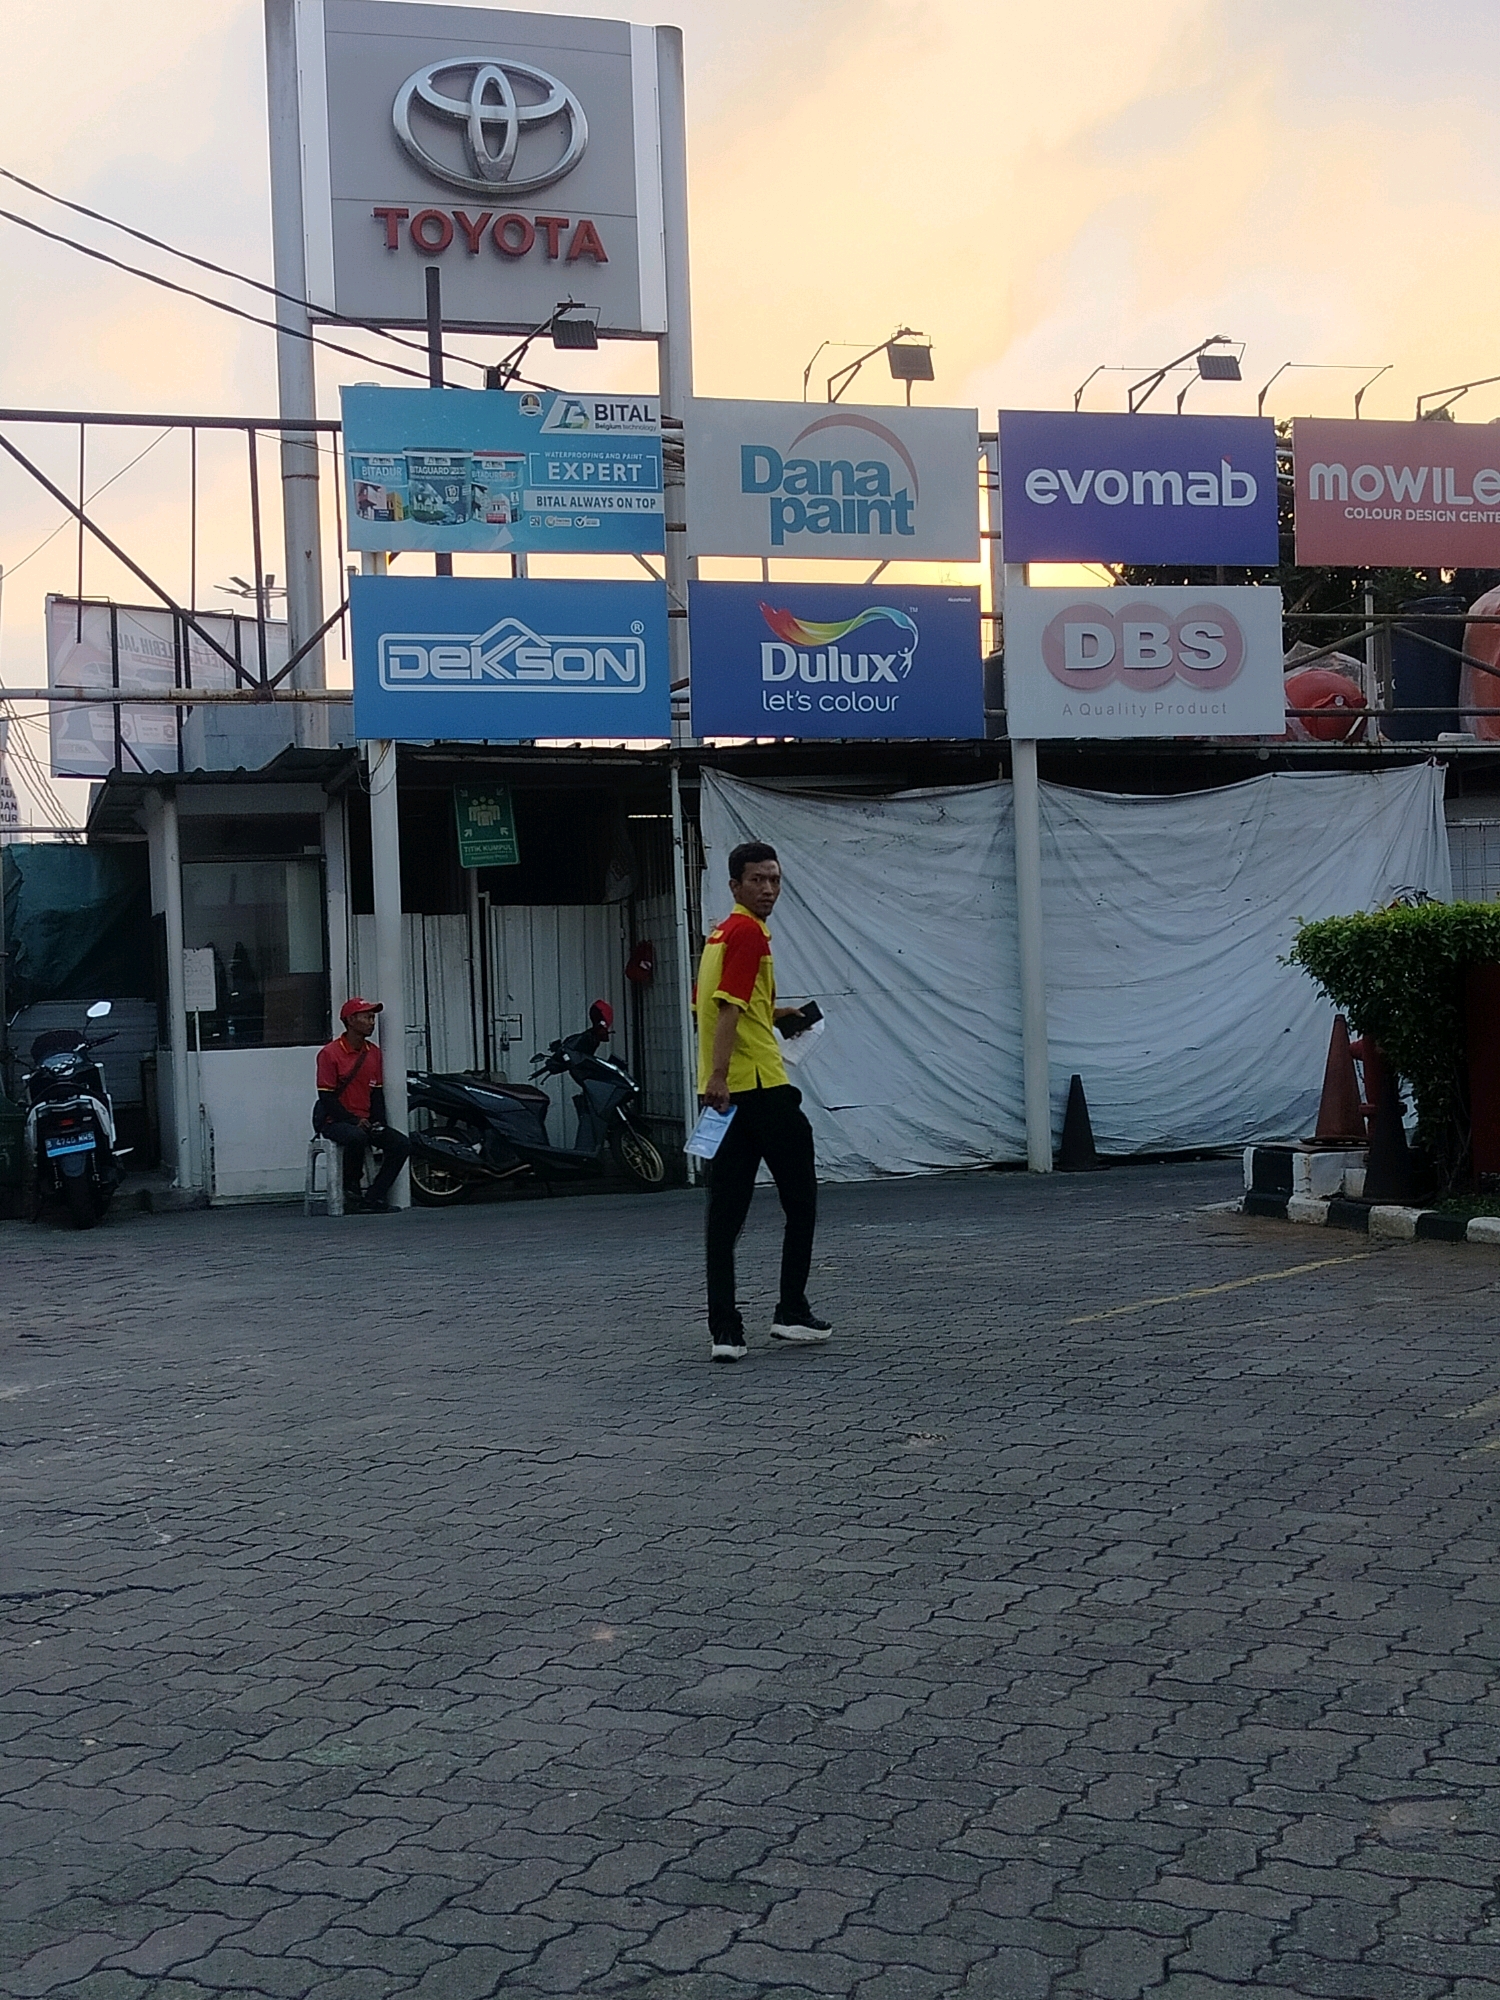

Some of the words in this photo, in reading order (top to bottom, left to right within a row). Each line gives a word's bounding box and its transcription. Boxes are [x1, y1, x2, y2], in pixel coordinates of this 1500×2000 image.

[373, 207, 609, 263] TOYOTA
[594, 403, 657, 422] BITAL
[544, 451, 604, 459] WATERPROOFING
[361, 466, 403, 477] BITADUR
[547, 461, 643, 482] EXPERT
[740, 444, 892, 497] Dana
[1025, 458, 1258, 507] evomab
[536, 495, 567, 507] BITAL
[570, 497, 614, 508] ALWAYS
[616, 498, 633, 508] ON
[636, 498, 656, 509] TOP
[770, 487, 916, 546] paint
[1344, 507, 1402, 521] COLOUR
[1405, 509, 1456, 522] DESIGN
[1064, 621, 1228, 671] DBS
[760, 642, 899, 684] Dulux
[762, 690, 813, 712] let's
[818, 691, 900, 712] colour
[1062, 703, 1073, 716] A
[1079, 702, 1148, 718] Quality
[1154, 702, 1228, 715] Product
